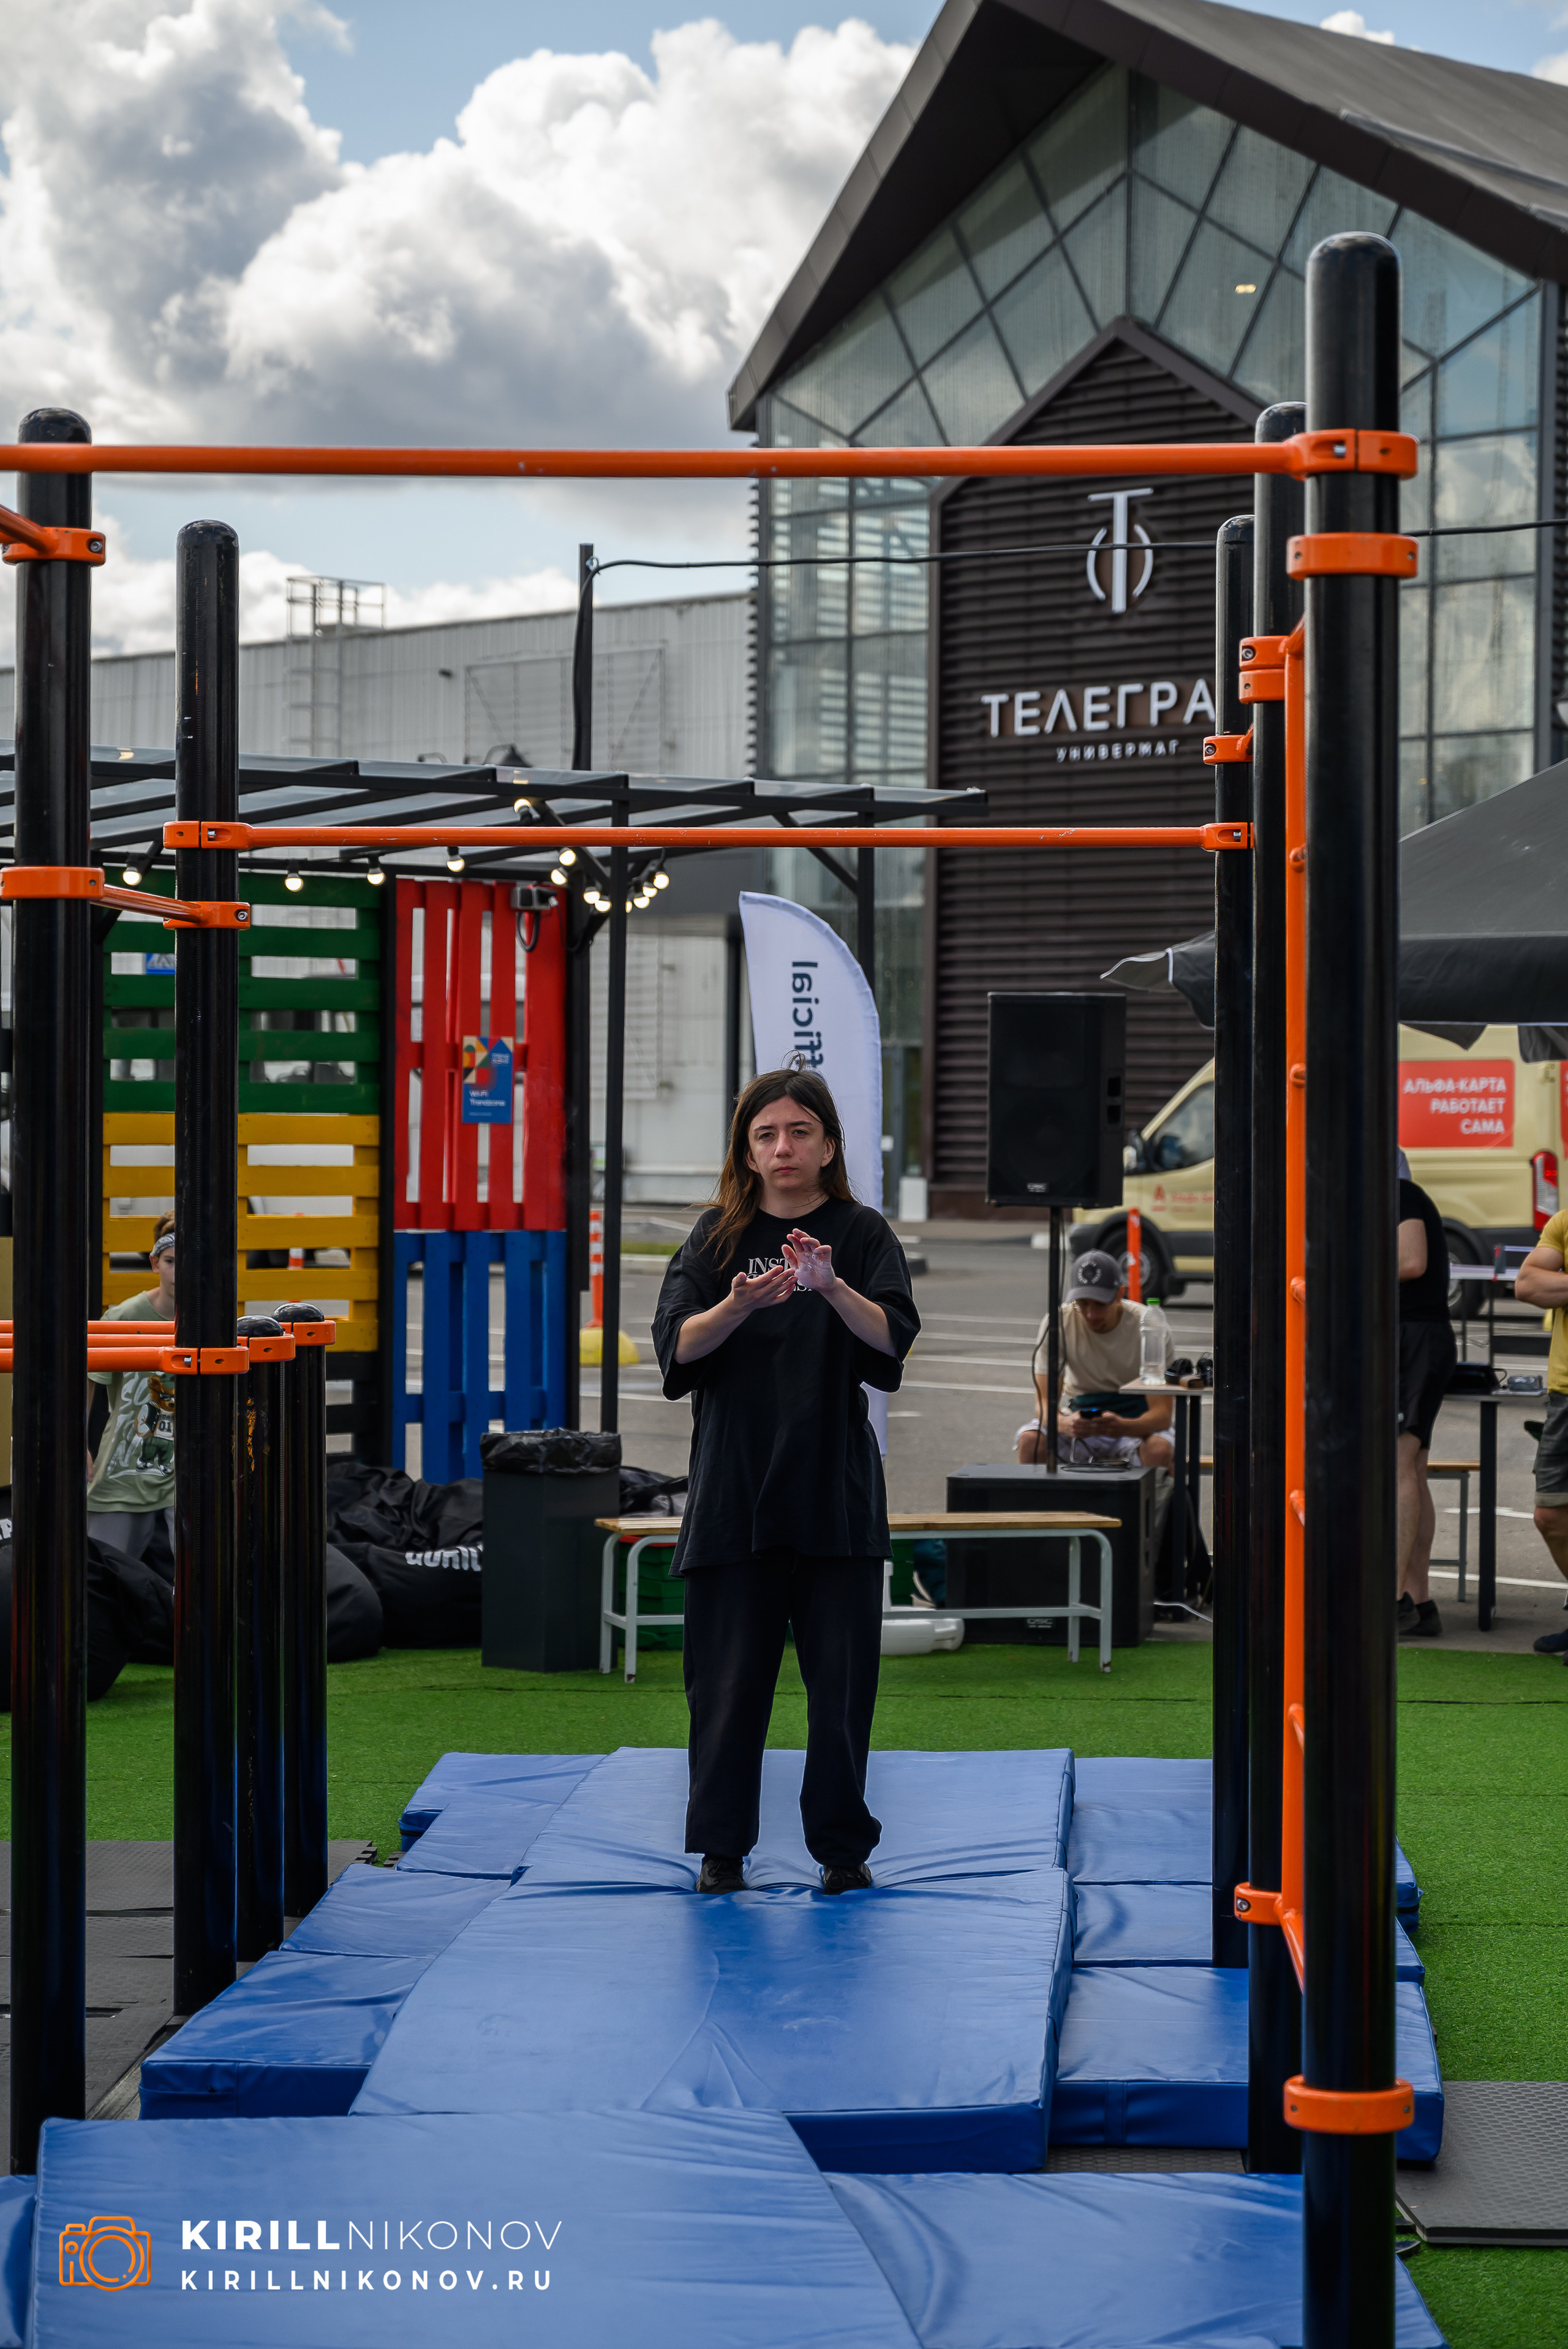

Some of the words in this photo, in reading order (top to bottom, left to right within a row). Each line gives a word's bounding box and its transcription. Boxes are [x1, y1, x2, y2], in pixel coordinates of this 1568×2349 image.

[981, 678, 1216, 737] ТЕЛЕГРА
[1056, 739, 1179, 762] УНИВЕРМАГ
[1404, 1078, 1506, 1094] АЛЬФА-КАРТА
[1430, 1097, 1506, 1114] РАБОТАЕТ
[1460, 1118, 1505, 1134] САМА
